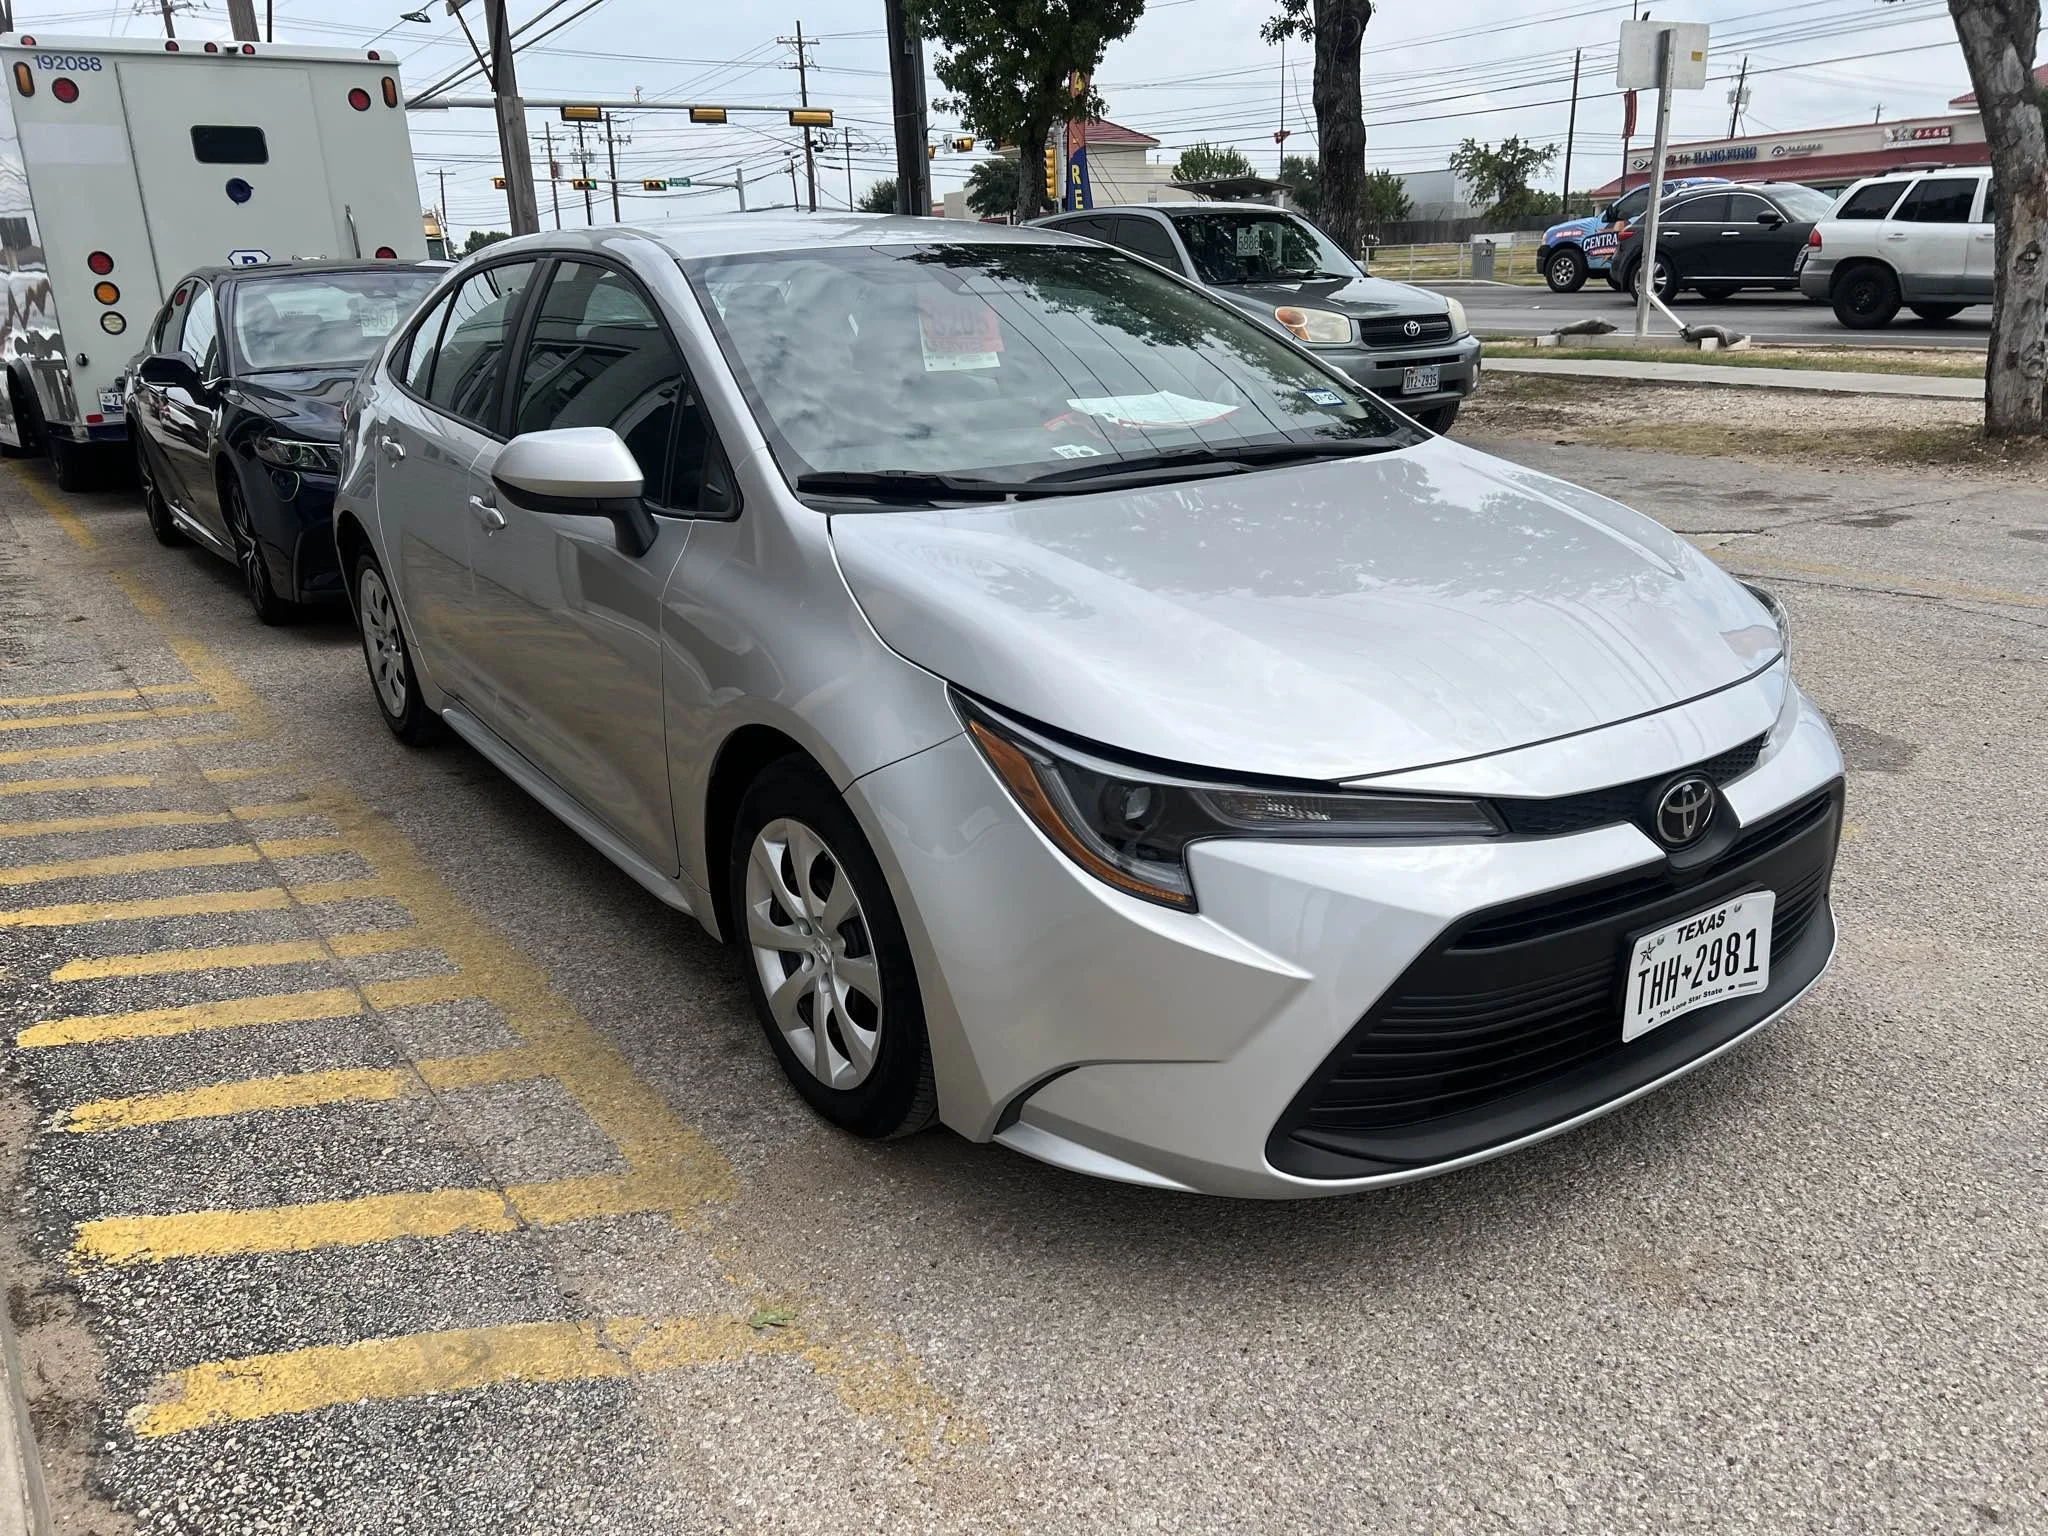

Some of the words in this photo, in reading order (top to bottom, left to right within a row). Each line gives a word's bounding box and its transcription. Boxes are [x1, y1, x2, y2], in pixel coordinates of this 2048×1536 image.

[32, 54, 102, 71] 192088
[1677, 909, 1727, 944] TEXAS
[1659, 1008, 1671, 1018] The
[1672, 1001, 1687, 1012] Lone
[1688, 993, 1702, 1004] Star
[1703, 987, 1723, 998] State
